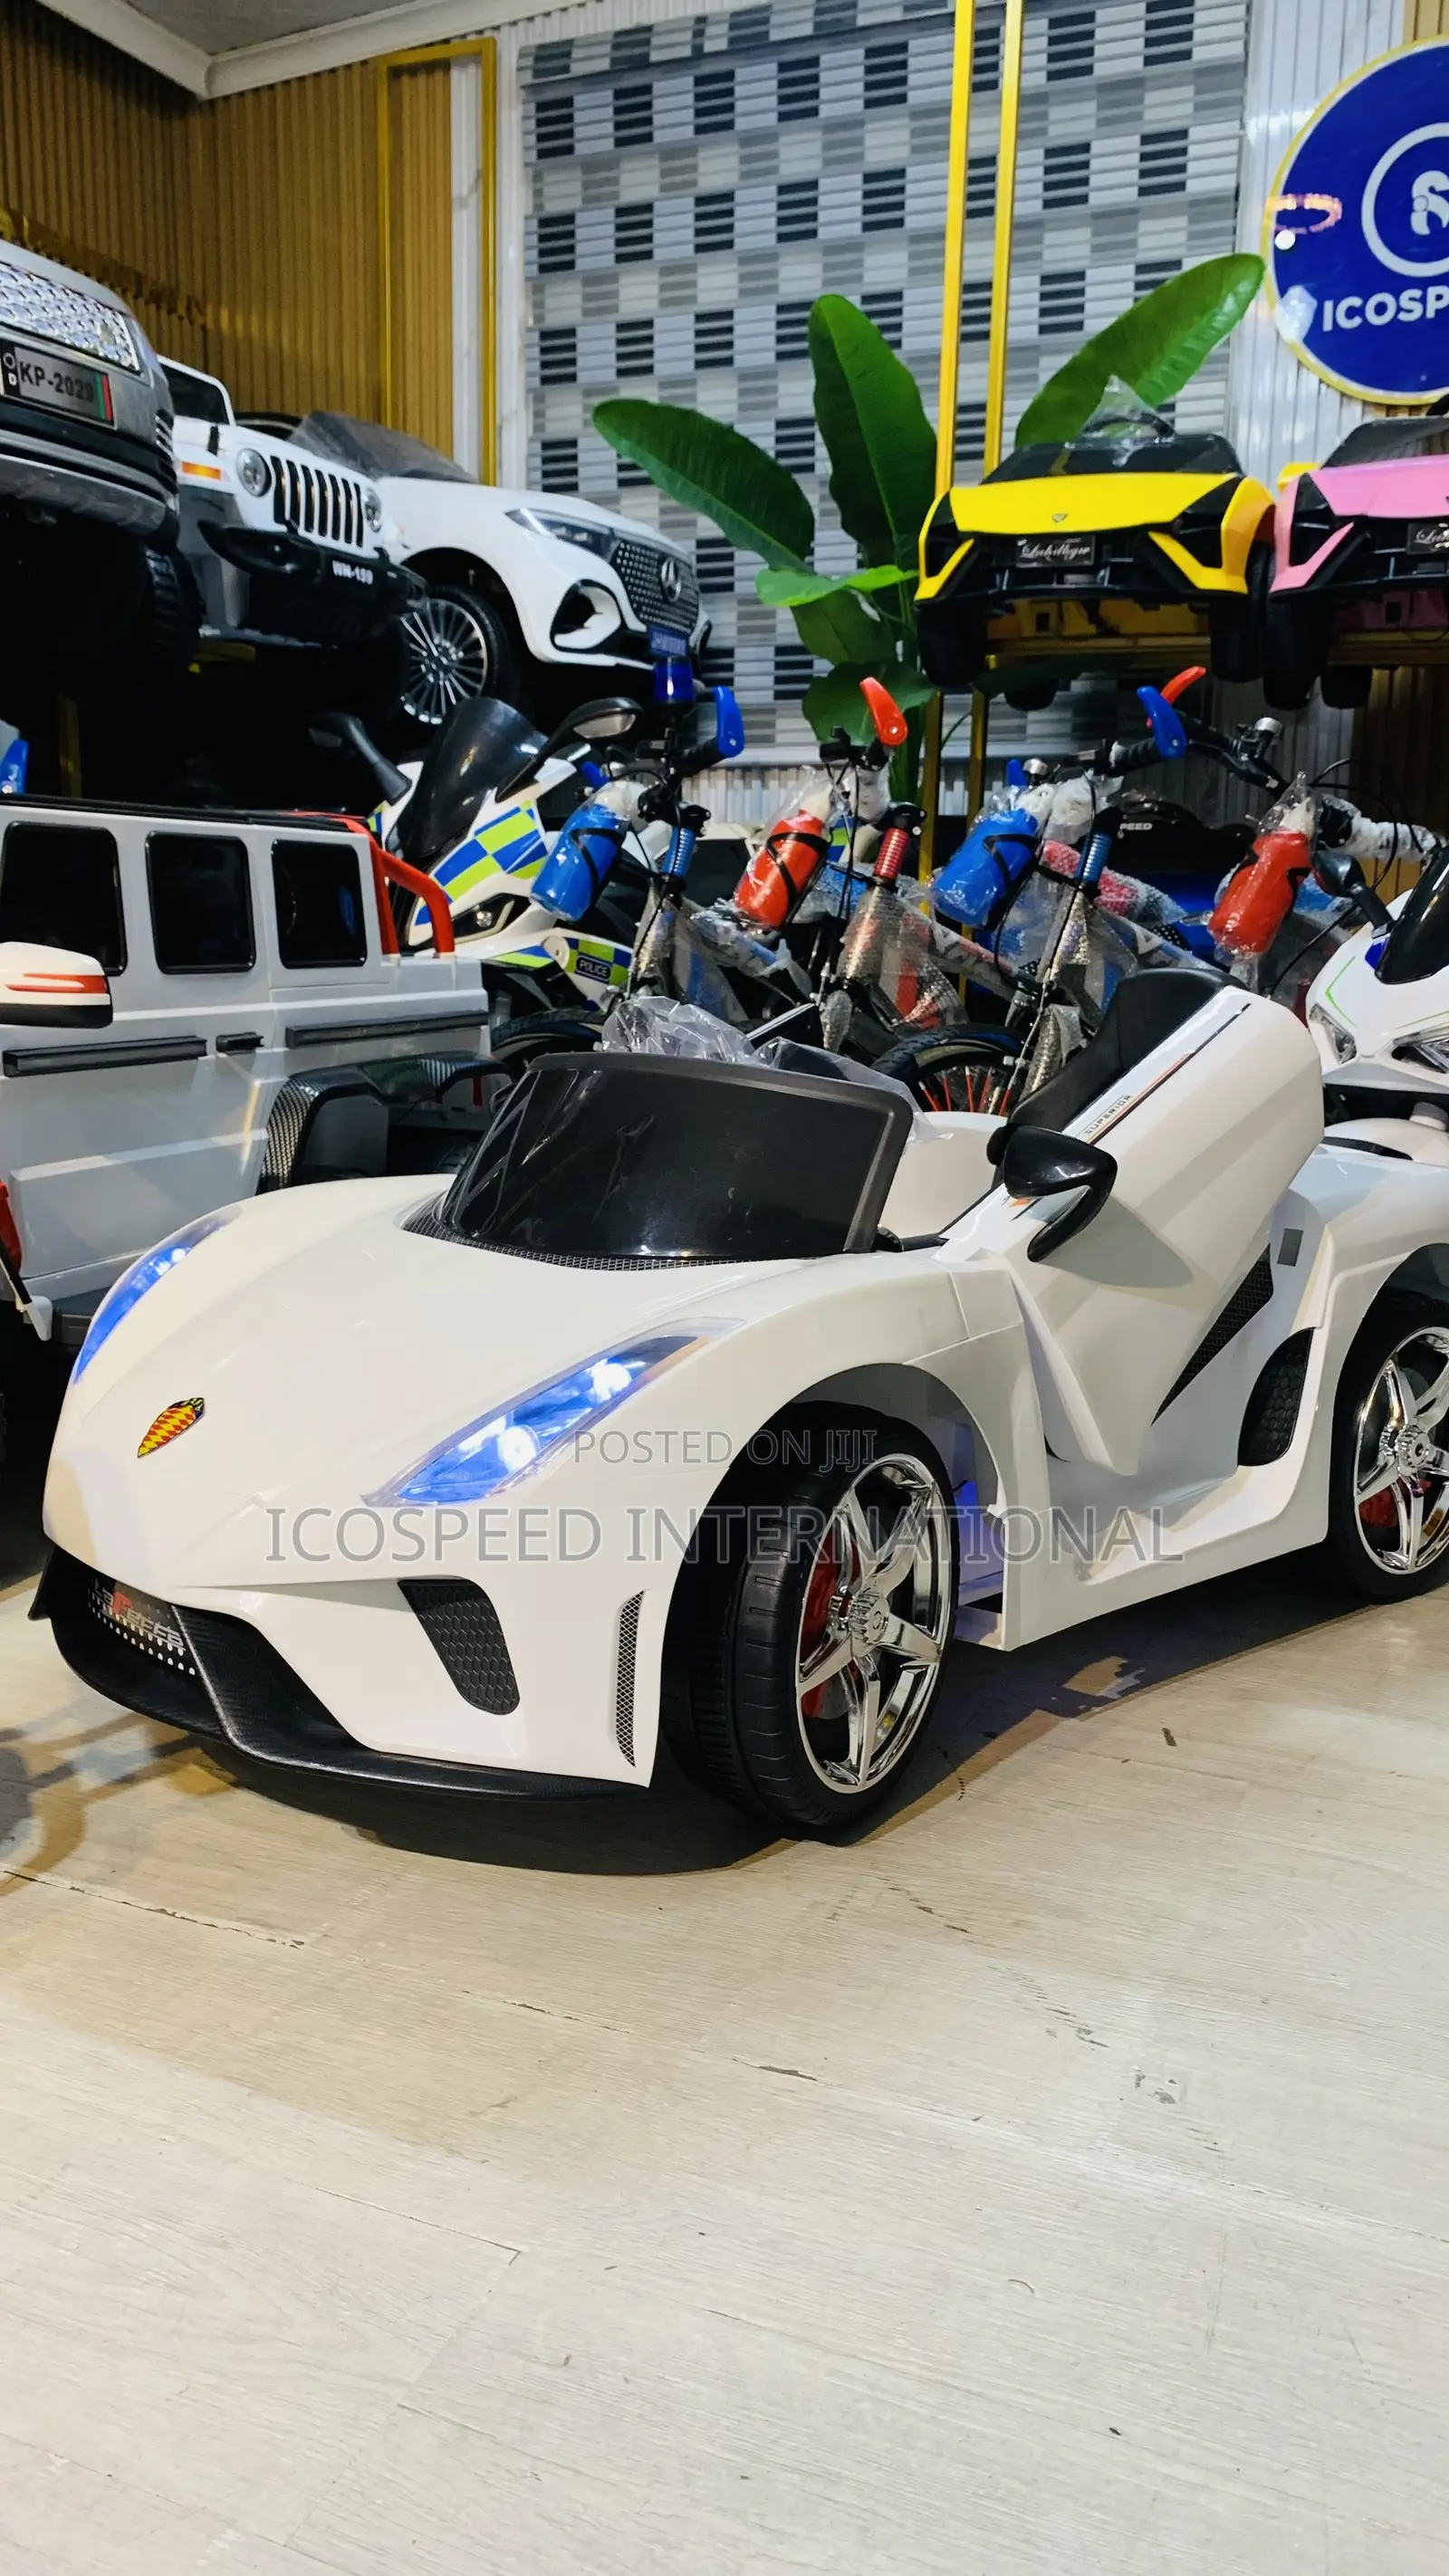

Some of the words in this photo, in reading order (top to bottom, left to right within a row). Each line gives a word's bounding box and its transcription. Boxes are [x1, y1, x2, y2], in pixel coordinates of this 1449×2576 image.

[1322, 285, 1449, 332] ICOSP
[579, 960, 609, 978] POLICE
[1084, 1094, 1132, 1135] SUPERIOR
